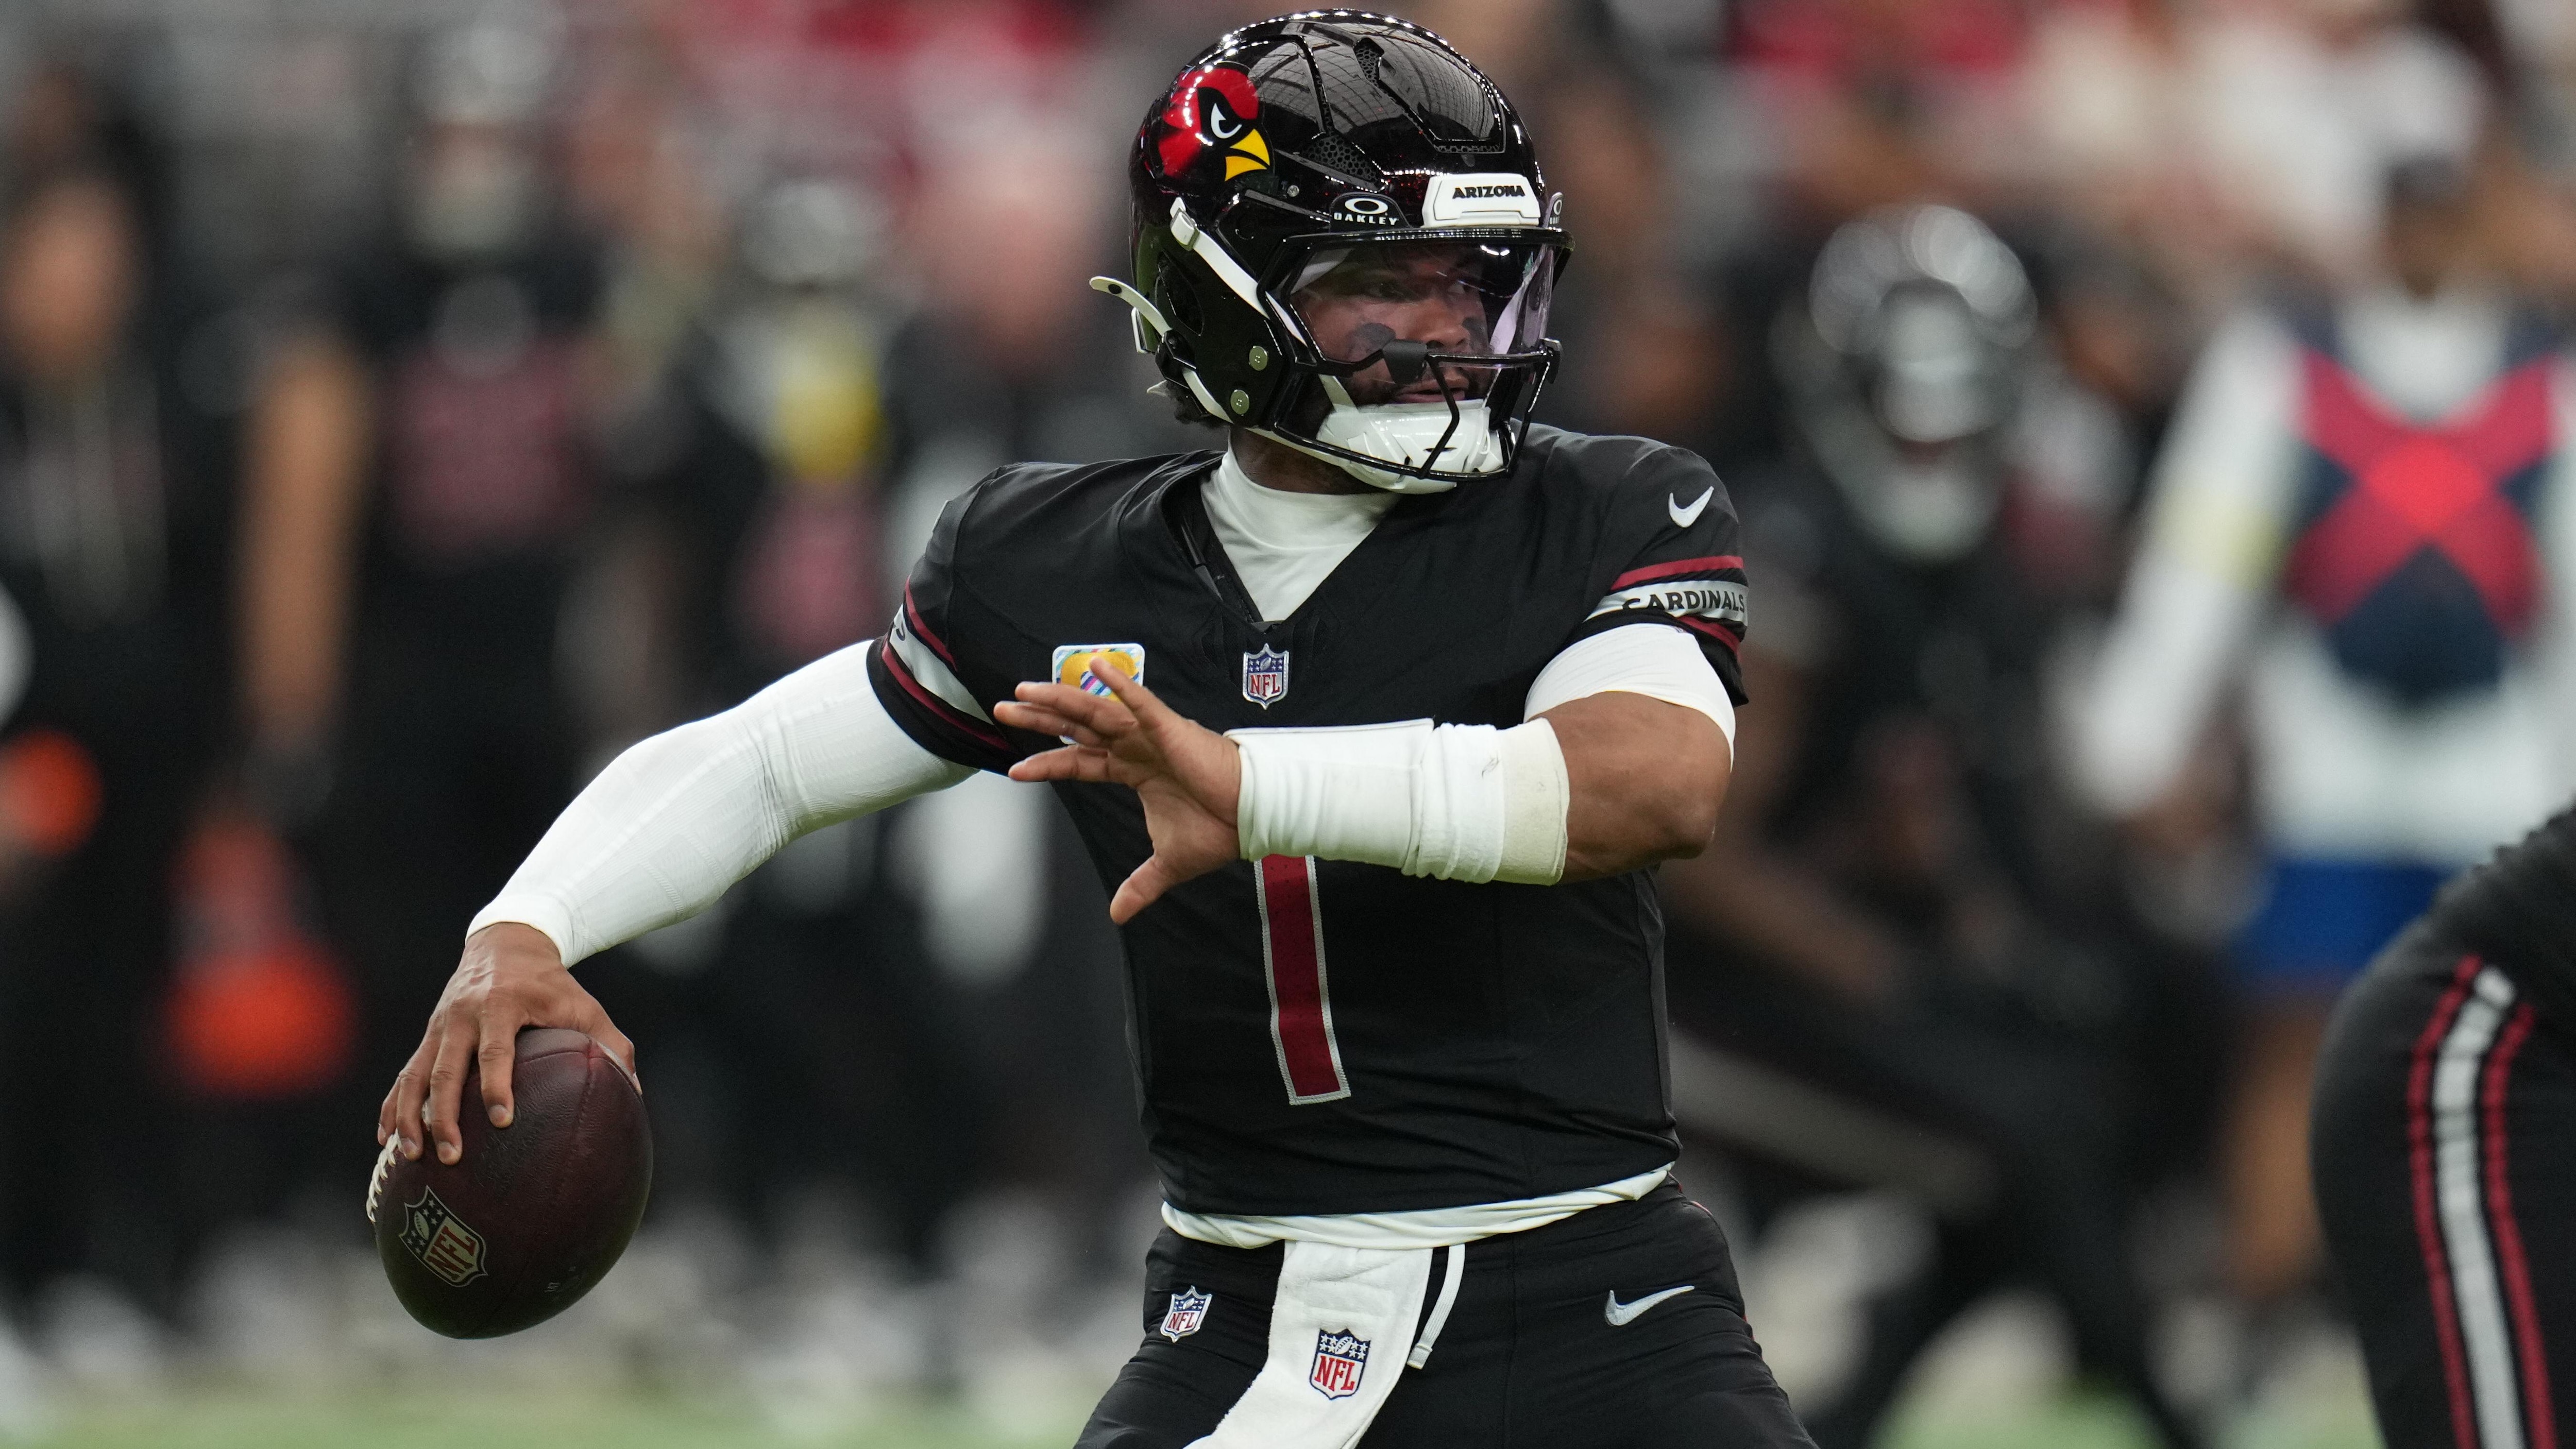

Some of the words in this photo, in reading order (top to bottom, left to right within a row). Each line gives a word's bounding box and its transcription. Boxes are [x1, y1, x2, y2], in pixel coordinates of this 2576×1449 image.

[1452, 185, 1526, 199] ARIZONA
[1333, 212, 1398, 226] OAKLEY
[1622, 589, 1745, 613] CARDINALS
[1250, 674, 1281, 697] NFL
[426, 1224, 477, 1281] NFL
[1167, 1312, 1196, 1331] NFL
[1314, 1355, 1356, 1391] NFL
